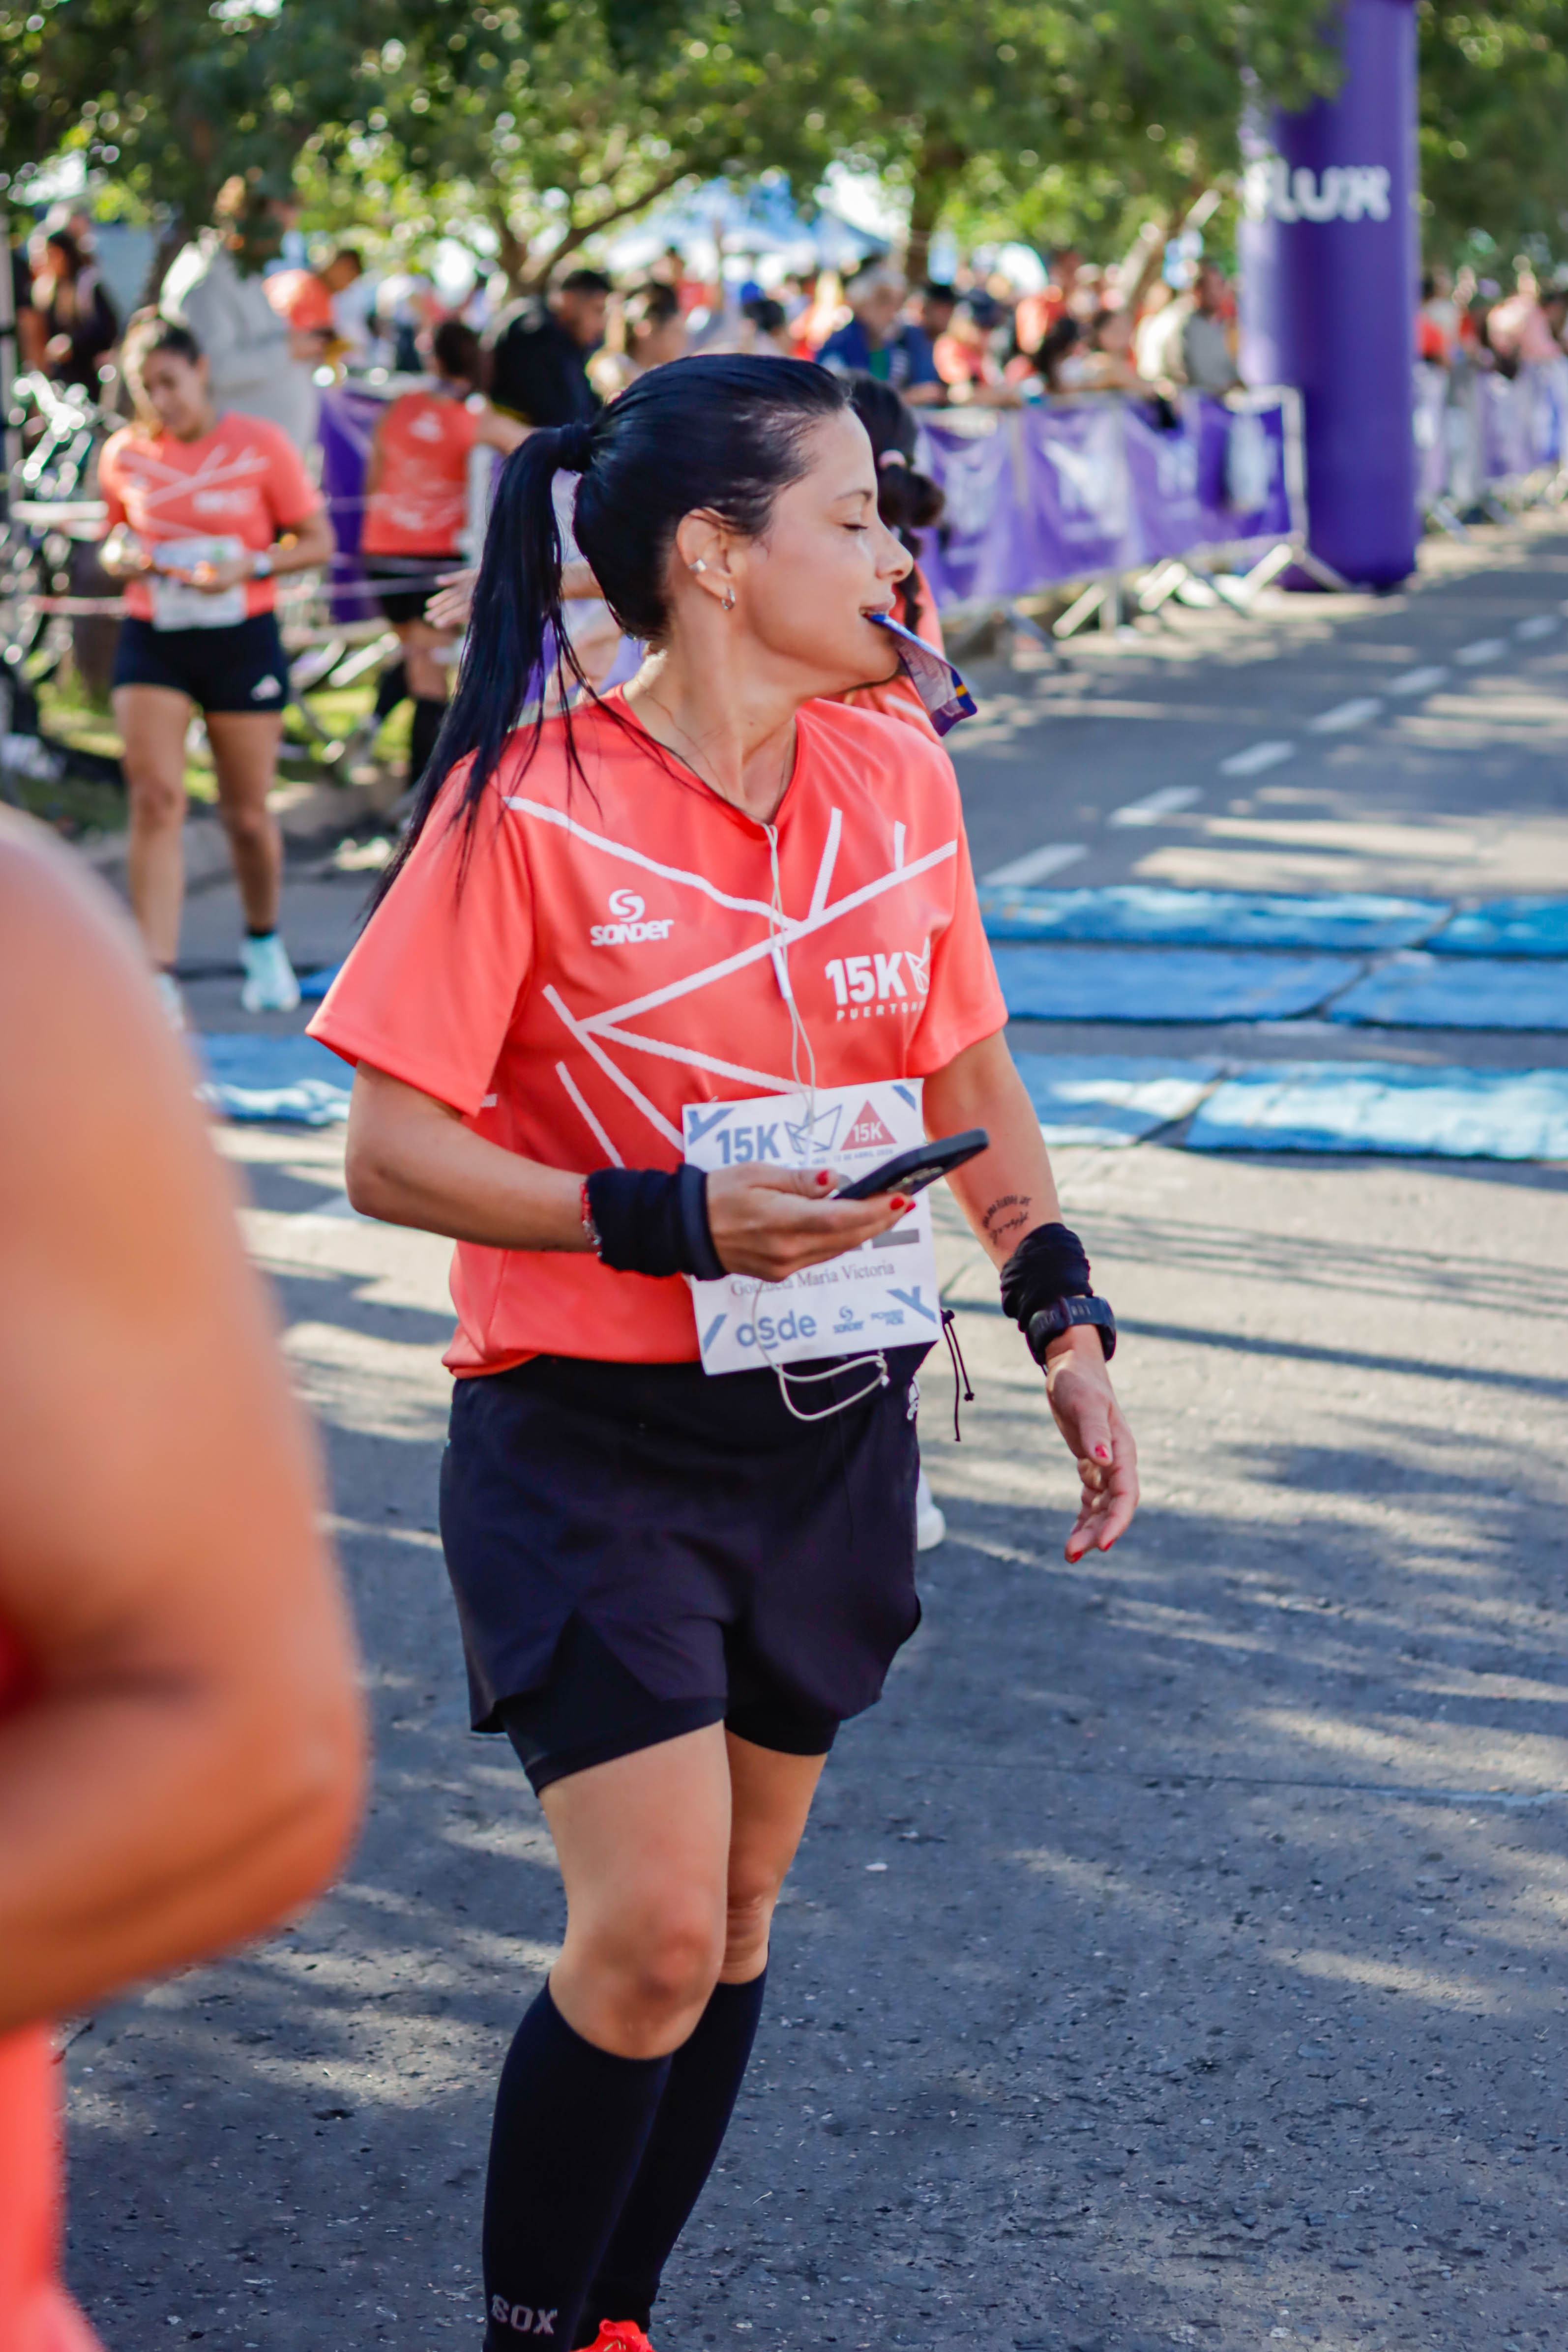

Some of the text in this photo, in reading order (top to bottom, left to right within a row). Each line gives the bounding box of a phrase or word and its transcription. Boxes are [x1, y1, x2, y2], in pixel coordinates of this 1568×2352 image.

[825, 951, 908, 1006] 15K
[716, 1123, 781, 1164] 15K
[853, 1120, 883, 1143] 15K
[841, 1260, 895, 1280] Victoria
[735, 1310, 817, 1350] osde
